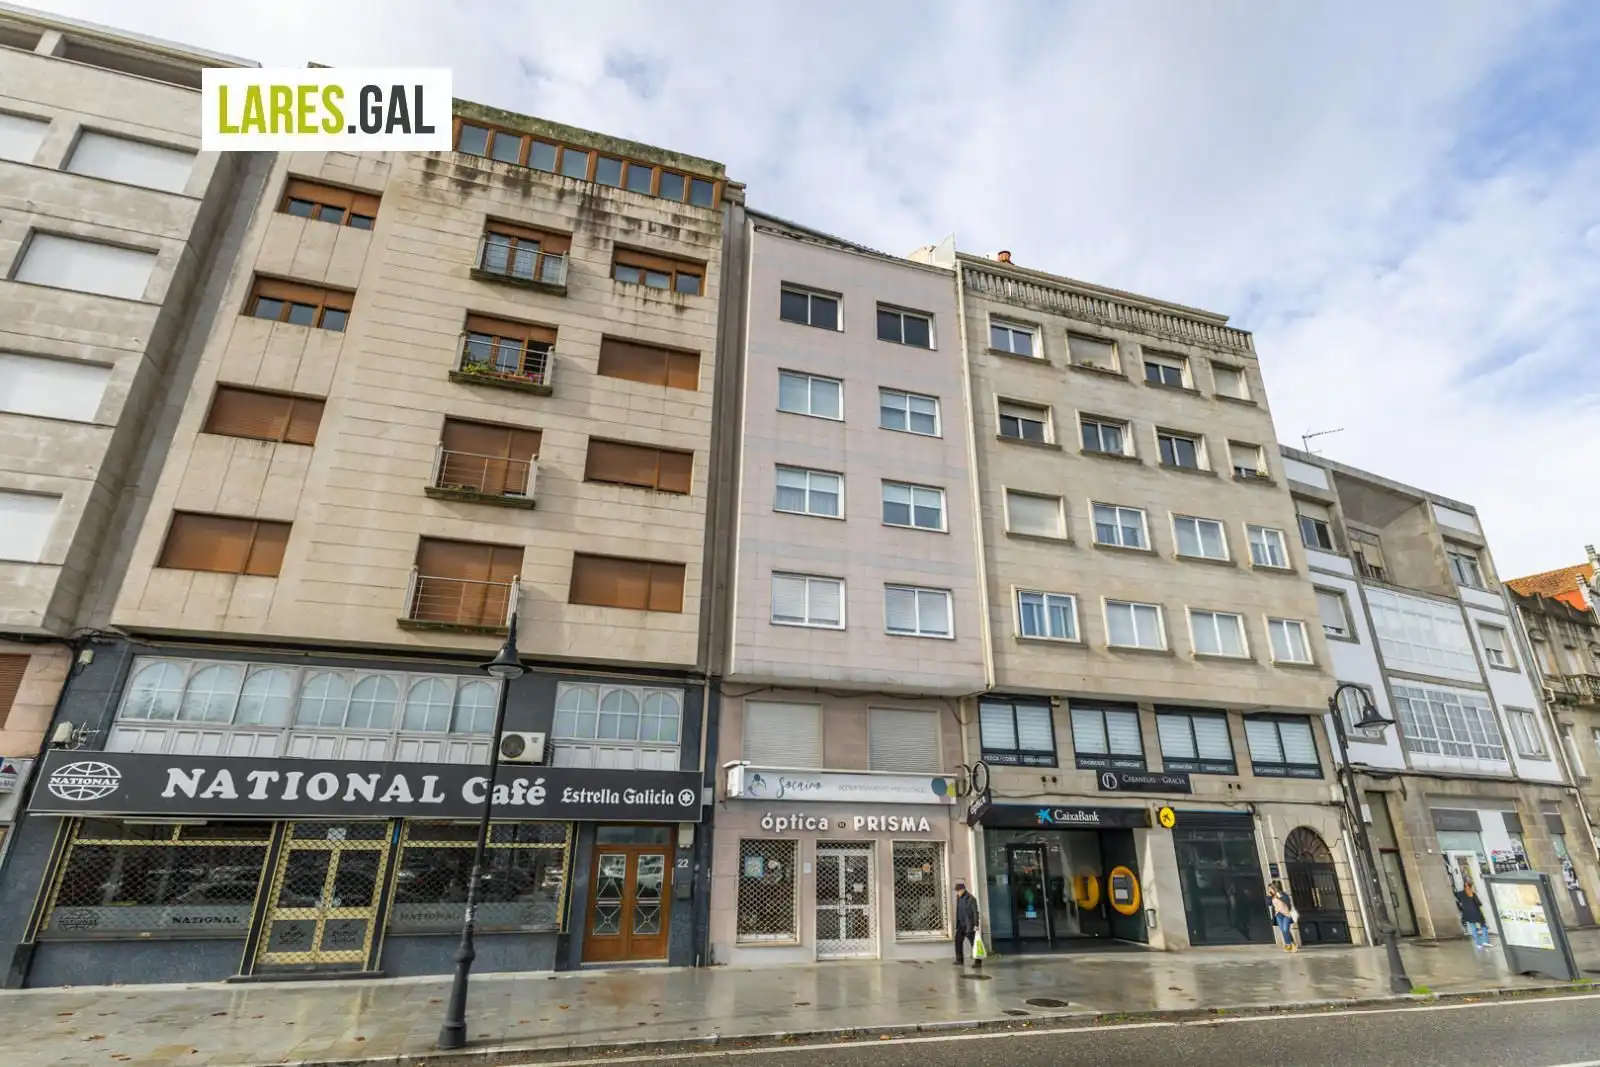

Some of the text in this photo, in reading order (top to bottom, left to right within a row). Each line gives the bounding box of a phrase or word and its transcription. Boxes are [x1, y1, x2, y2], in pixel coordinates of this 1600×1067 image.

[50, 777, 119, 787] NATIONAL
[161, 767, 546, 806] NATIONAL Café
[560, 786, 674, 805] Estrella Galicia
[761, 812, 931, 833] óptica PRISMA
[1054, 808, 1100, 823] CaixaBank
[677, 858, 689, 869] 22
[171, 915, 241, 925] NATIONAL
